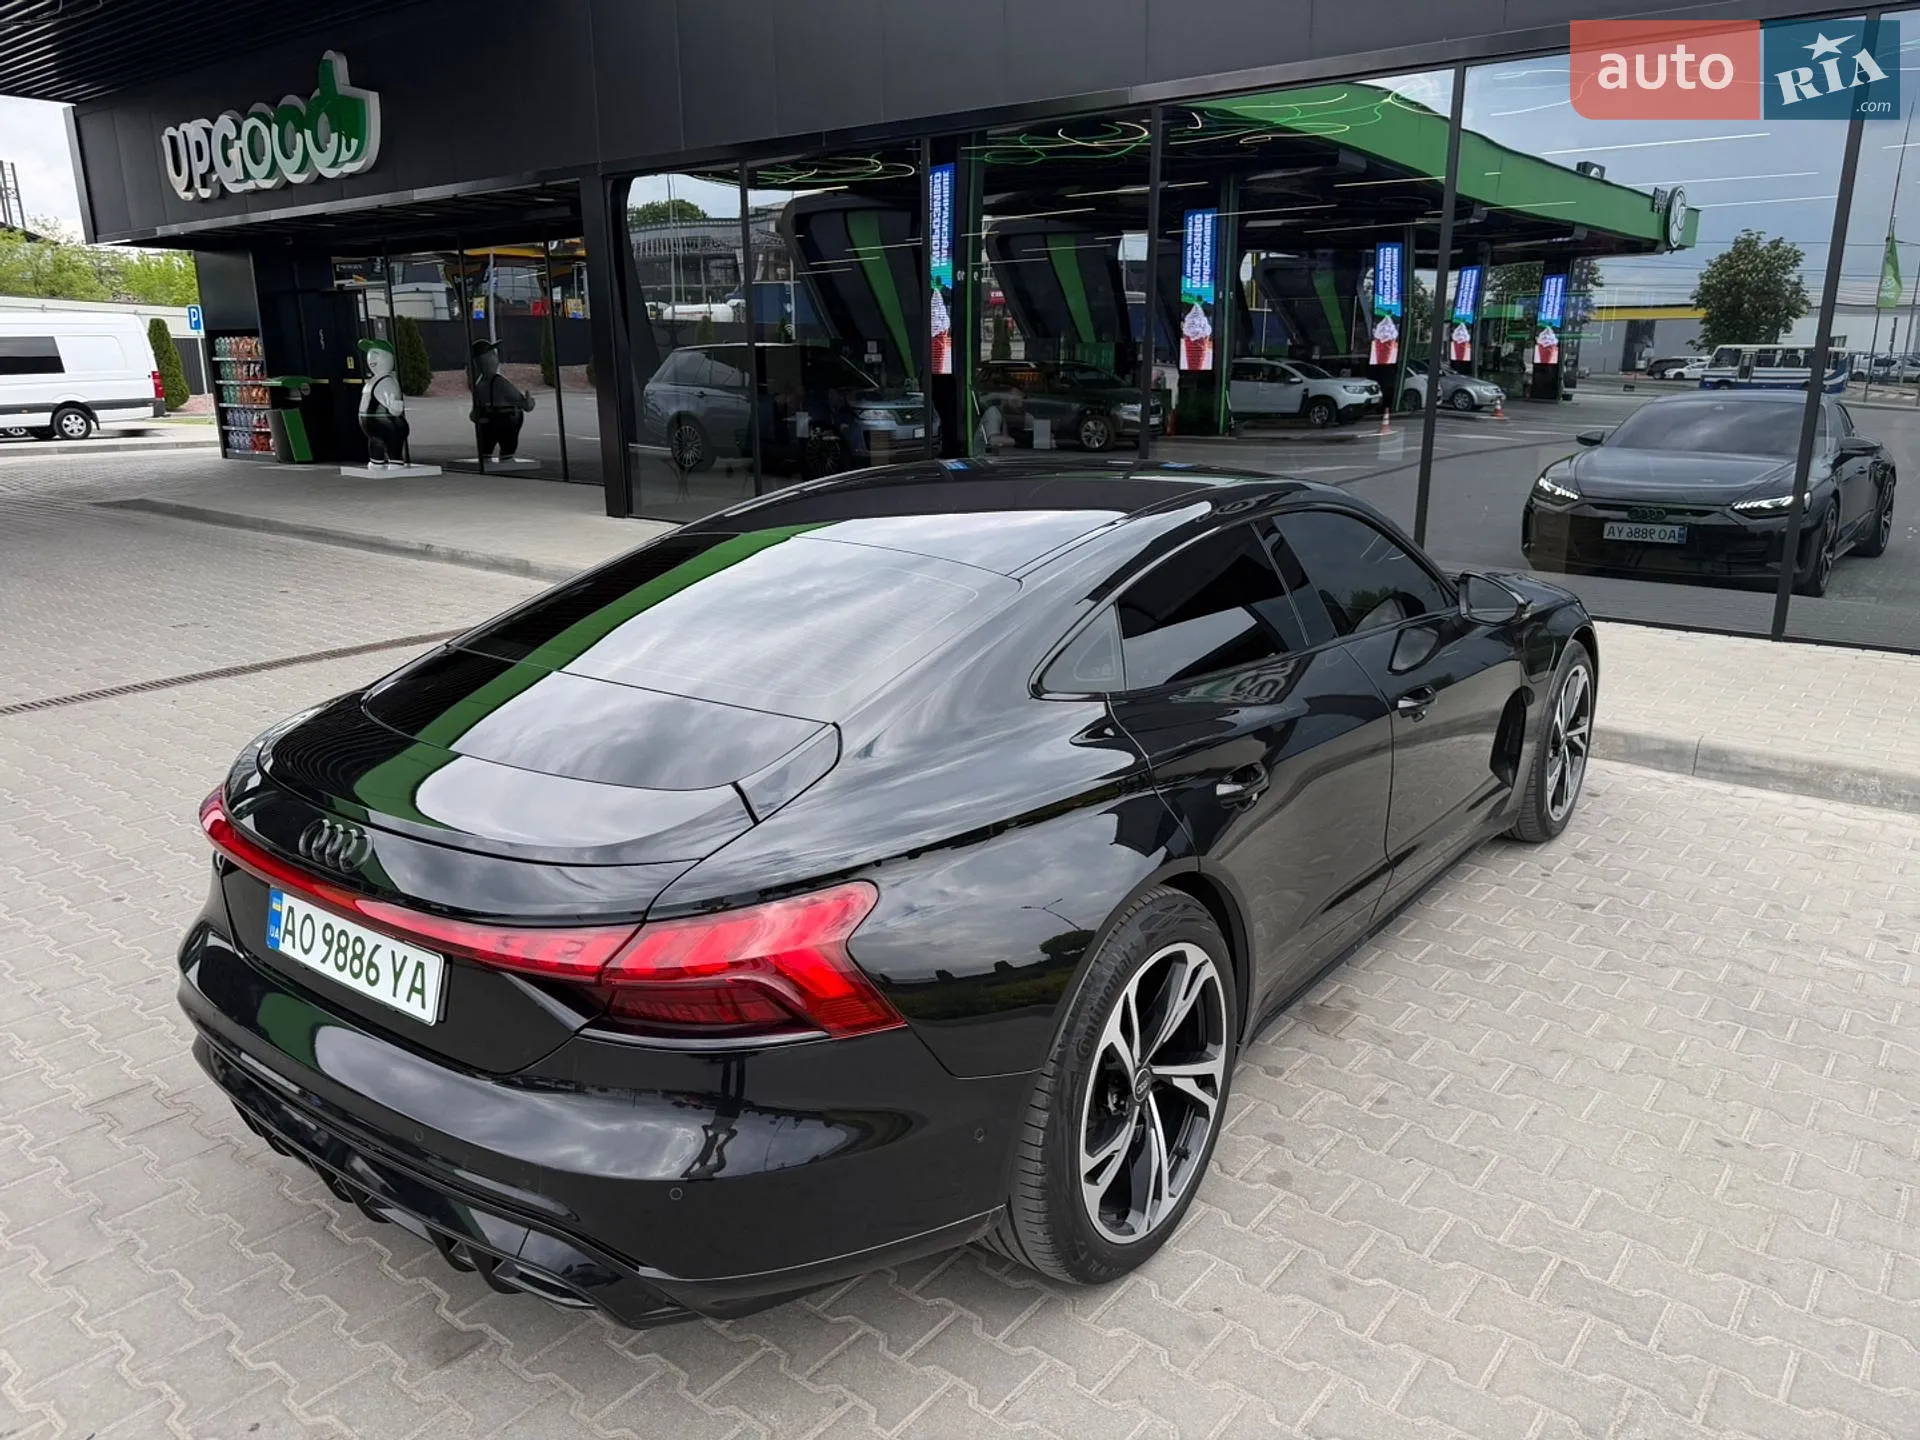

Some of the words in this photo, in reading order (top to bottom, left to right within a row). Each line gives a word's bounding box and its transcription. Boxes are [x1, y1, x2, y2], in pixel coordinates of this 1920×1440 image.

[190, 308, 199, 329] P
[282, 905, 316, 956] AO
[320, 922, 383, 987] 9886
[390, 949, 427, 1010] YA
[1076, 949, 1133, 1061] Continental
